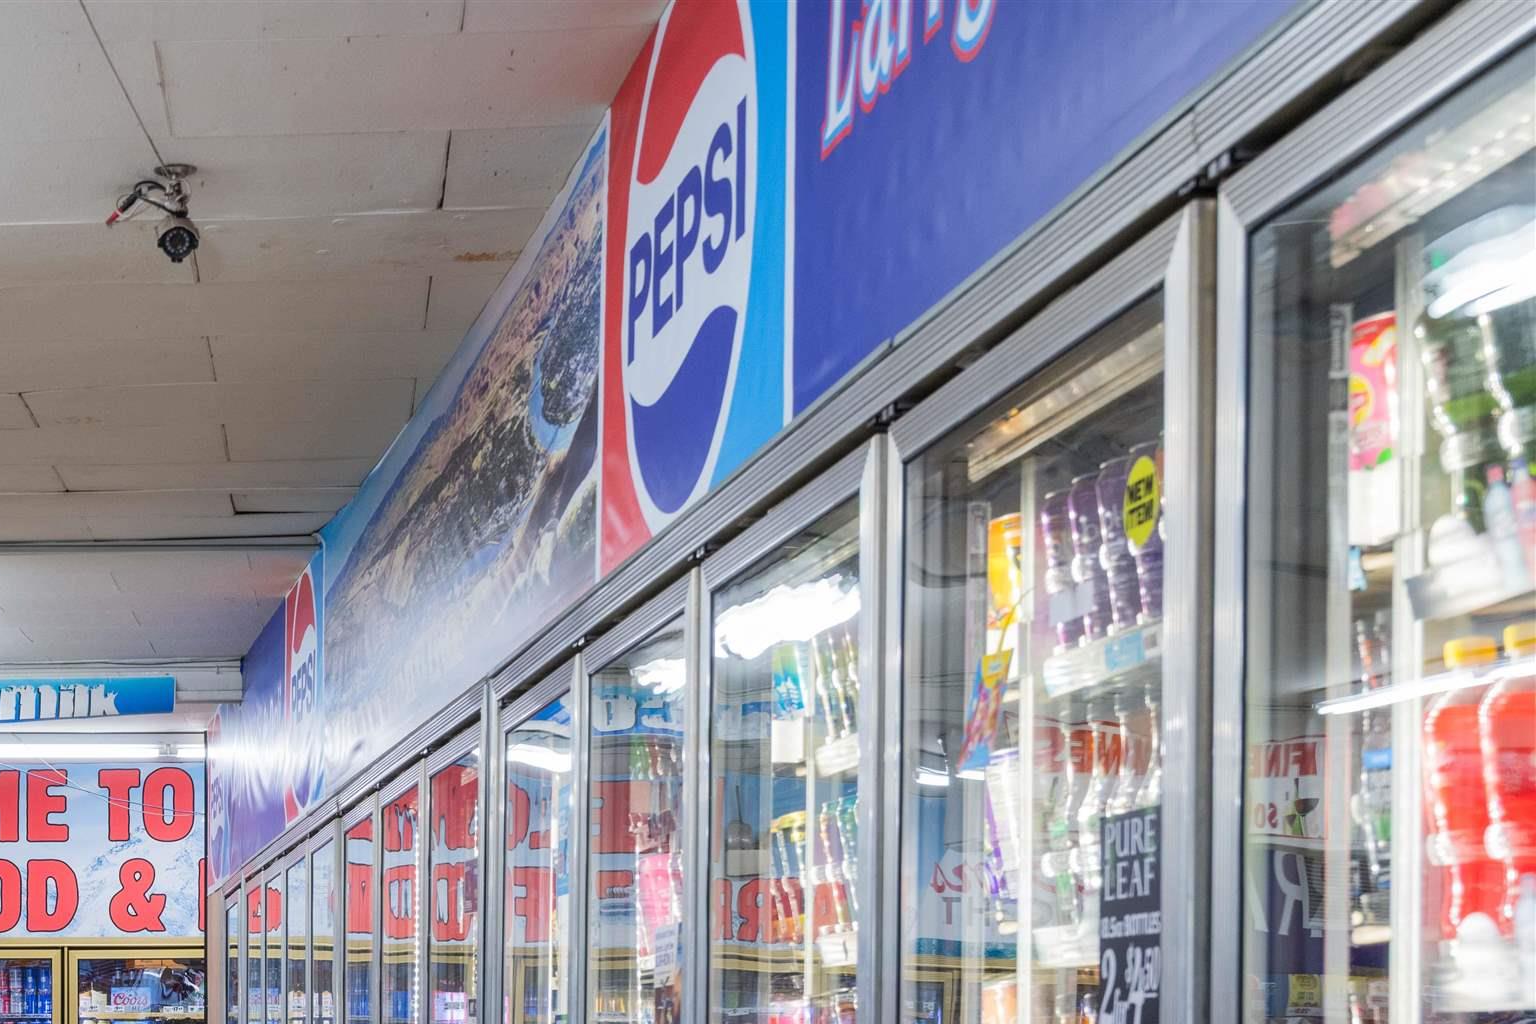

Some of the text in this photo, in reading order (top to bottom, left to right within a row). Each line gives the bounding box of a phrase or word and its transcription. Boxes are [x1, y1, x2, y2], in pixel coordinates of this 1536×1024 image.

[627, 94, 748, 368] PEPSI
[1128, 474, 1154, 503] NEW
[98, 766, 195, 842] TO
[1103, 813, 1158, 860] PURE
[109, 858, 167, 933] &
[1103, 856, 1157, 902] LEAF
[113, 993, 148, 1007] Coors
